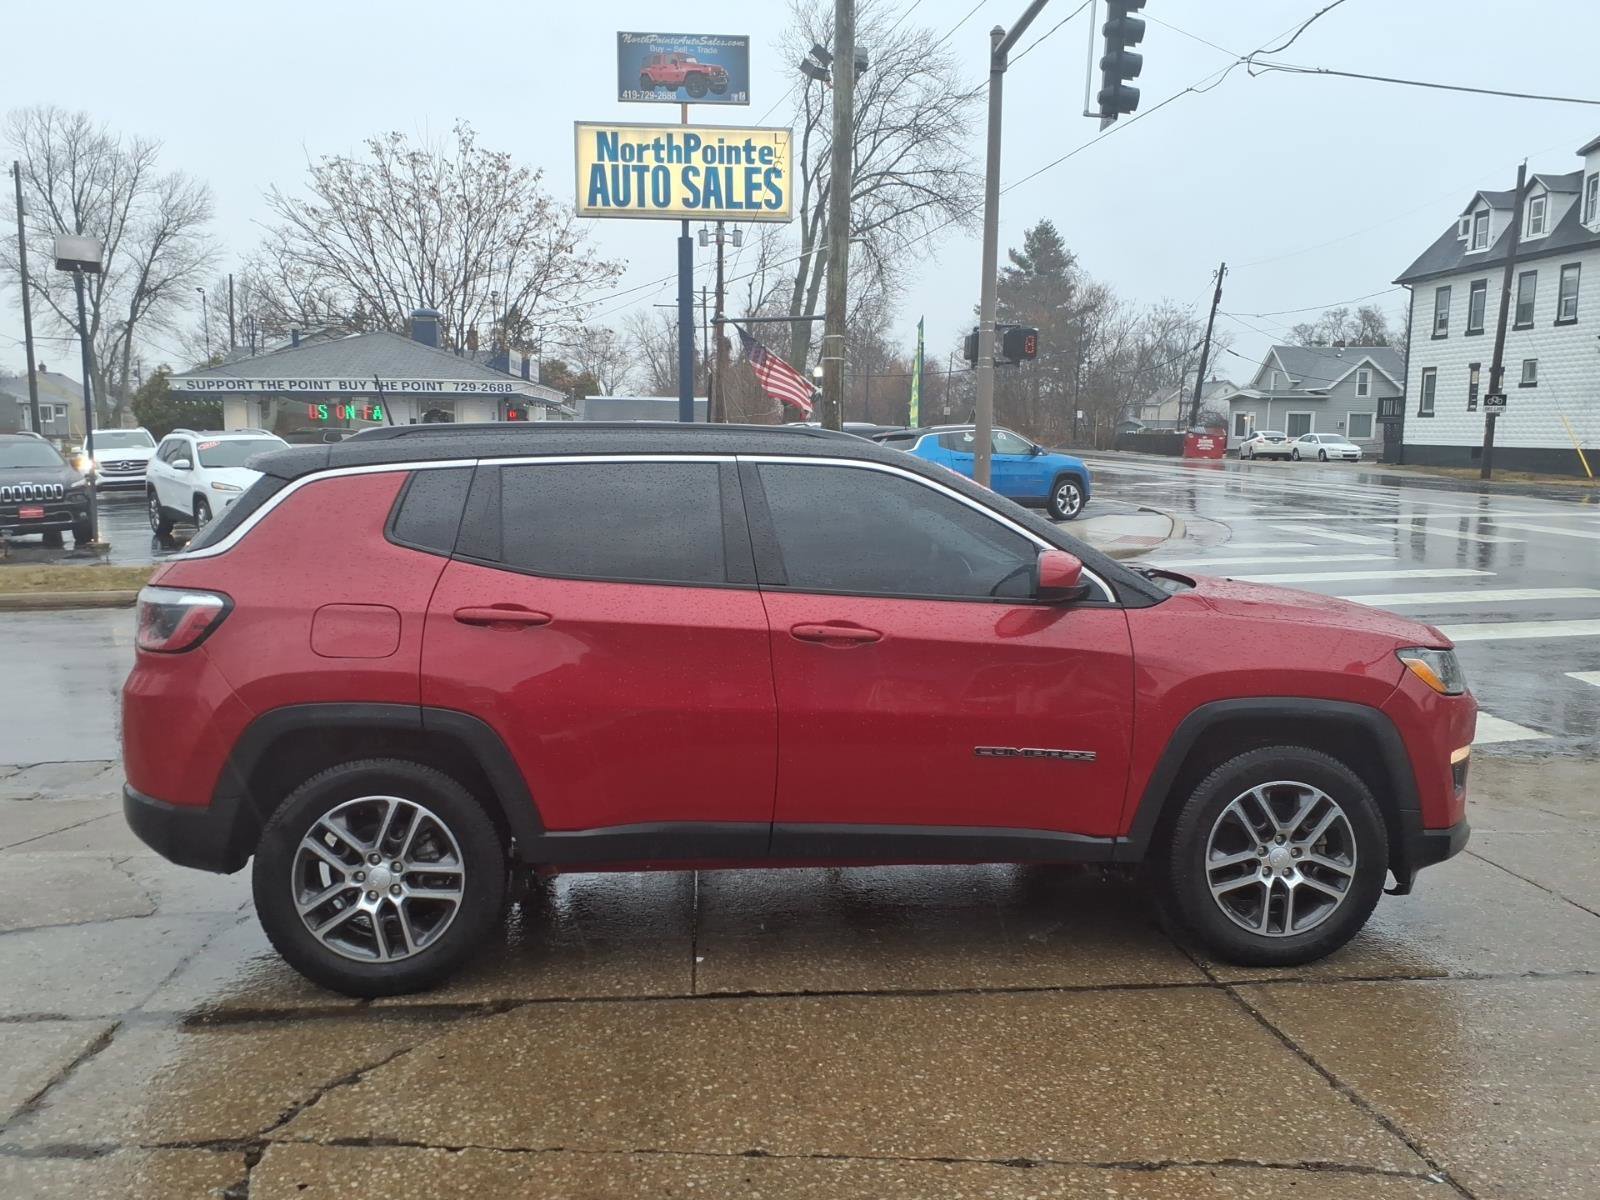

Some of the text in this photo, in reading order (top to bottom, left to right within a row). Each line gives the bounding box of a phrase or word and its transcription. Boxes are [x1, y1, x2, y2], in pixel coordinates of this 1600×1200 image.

[621, 33, 745, 47] NorthPointeAutoSales.com
[650, 45, 664, 53] Buy
[697, 46, 718, 54] Trade
[622, 89, 677, 100] 419-729-2688
[596, 131, 774, 165] NorthPointe
[588, 163, 783, 210] AUTO SALES
[186, 379, 513, 393] SUPPORT THE POINT BUY THE POINT 729-2688
[336, 404, 355, 419] ON
